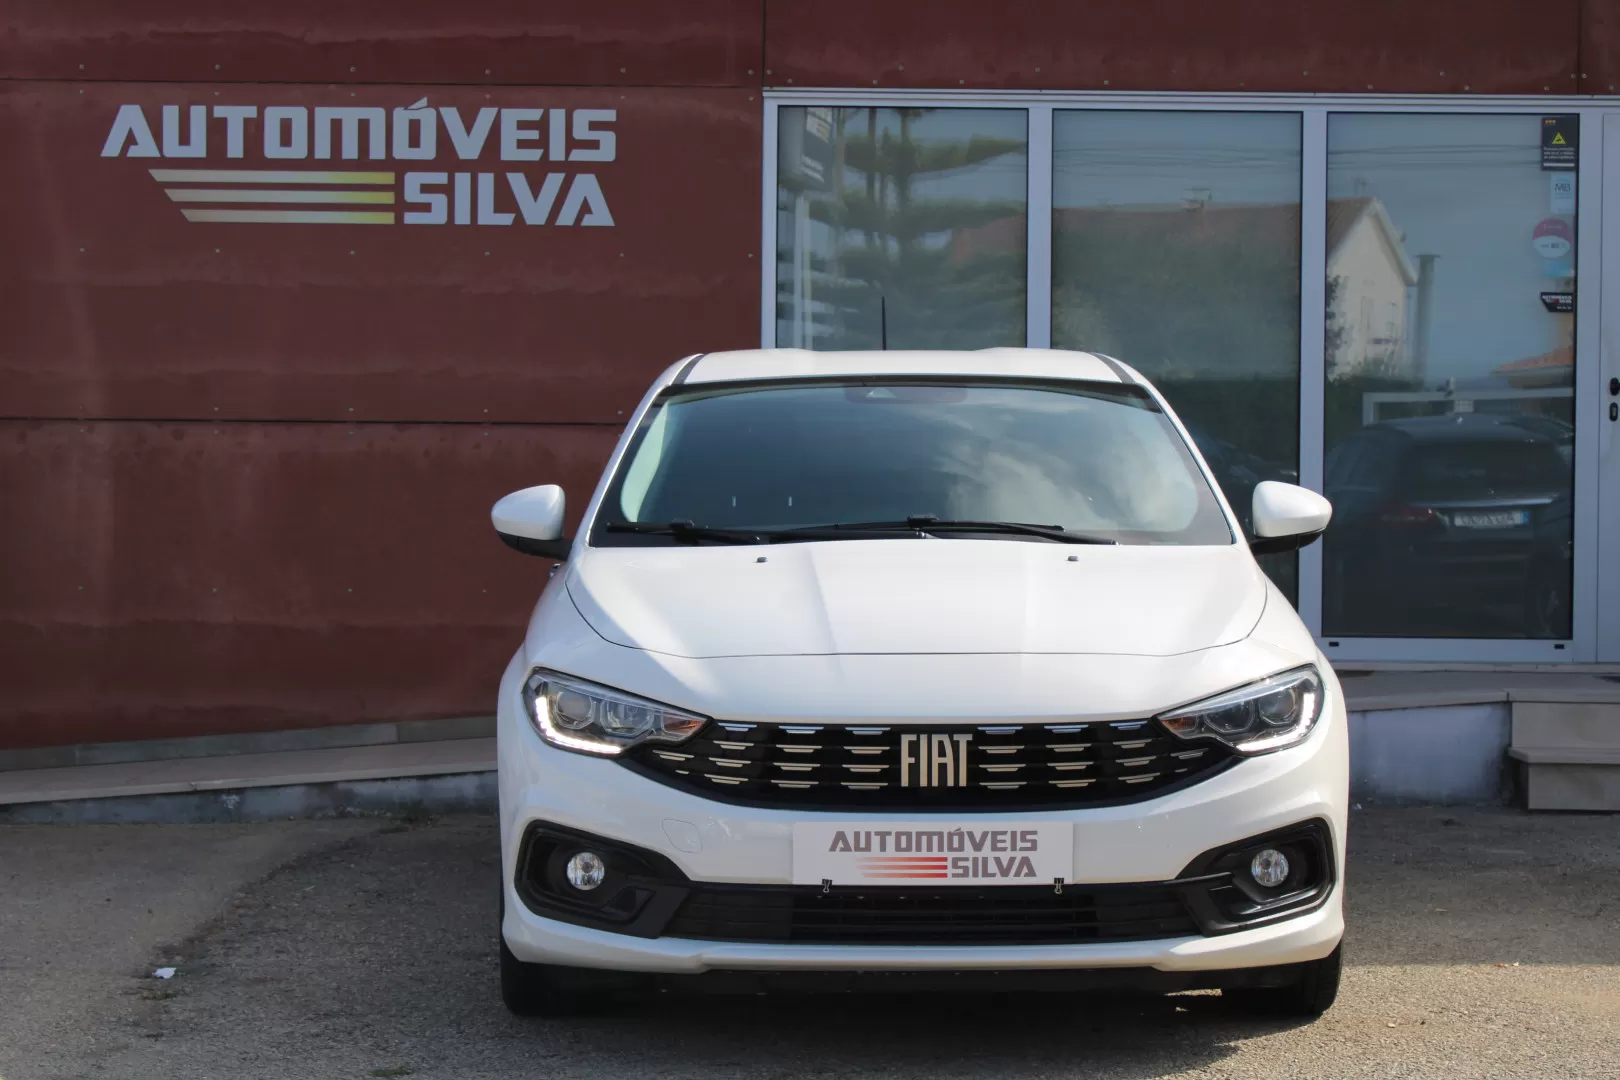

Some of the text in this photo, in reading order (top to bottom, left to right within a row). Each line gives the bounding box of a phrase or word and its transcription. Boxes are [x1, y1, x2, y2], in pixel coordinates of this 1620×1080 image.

[100, 97, 617, 163] AUTOMÓVEIS
[404, 172, 616, 227] SILVA
[901, 734, 973, 787] FIAT
[829, 827, 1038, 853] AUTOMÓVEIS
[951, 856, 1037, 878] SILVA
